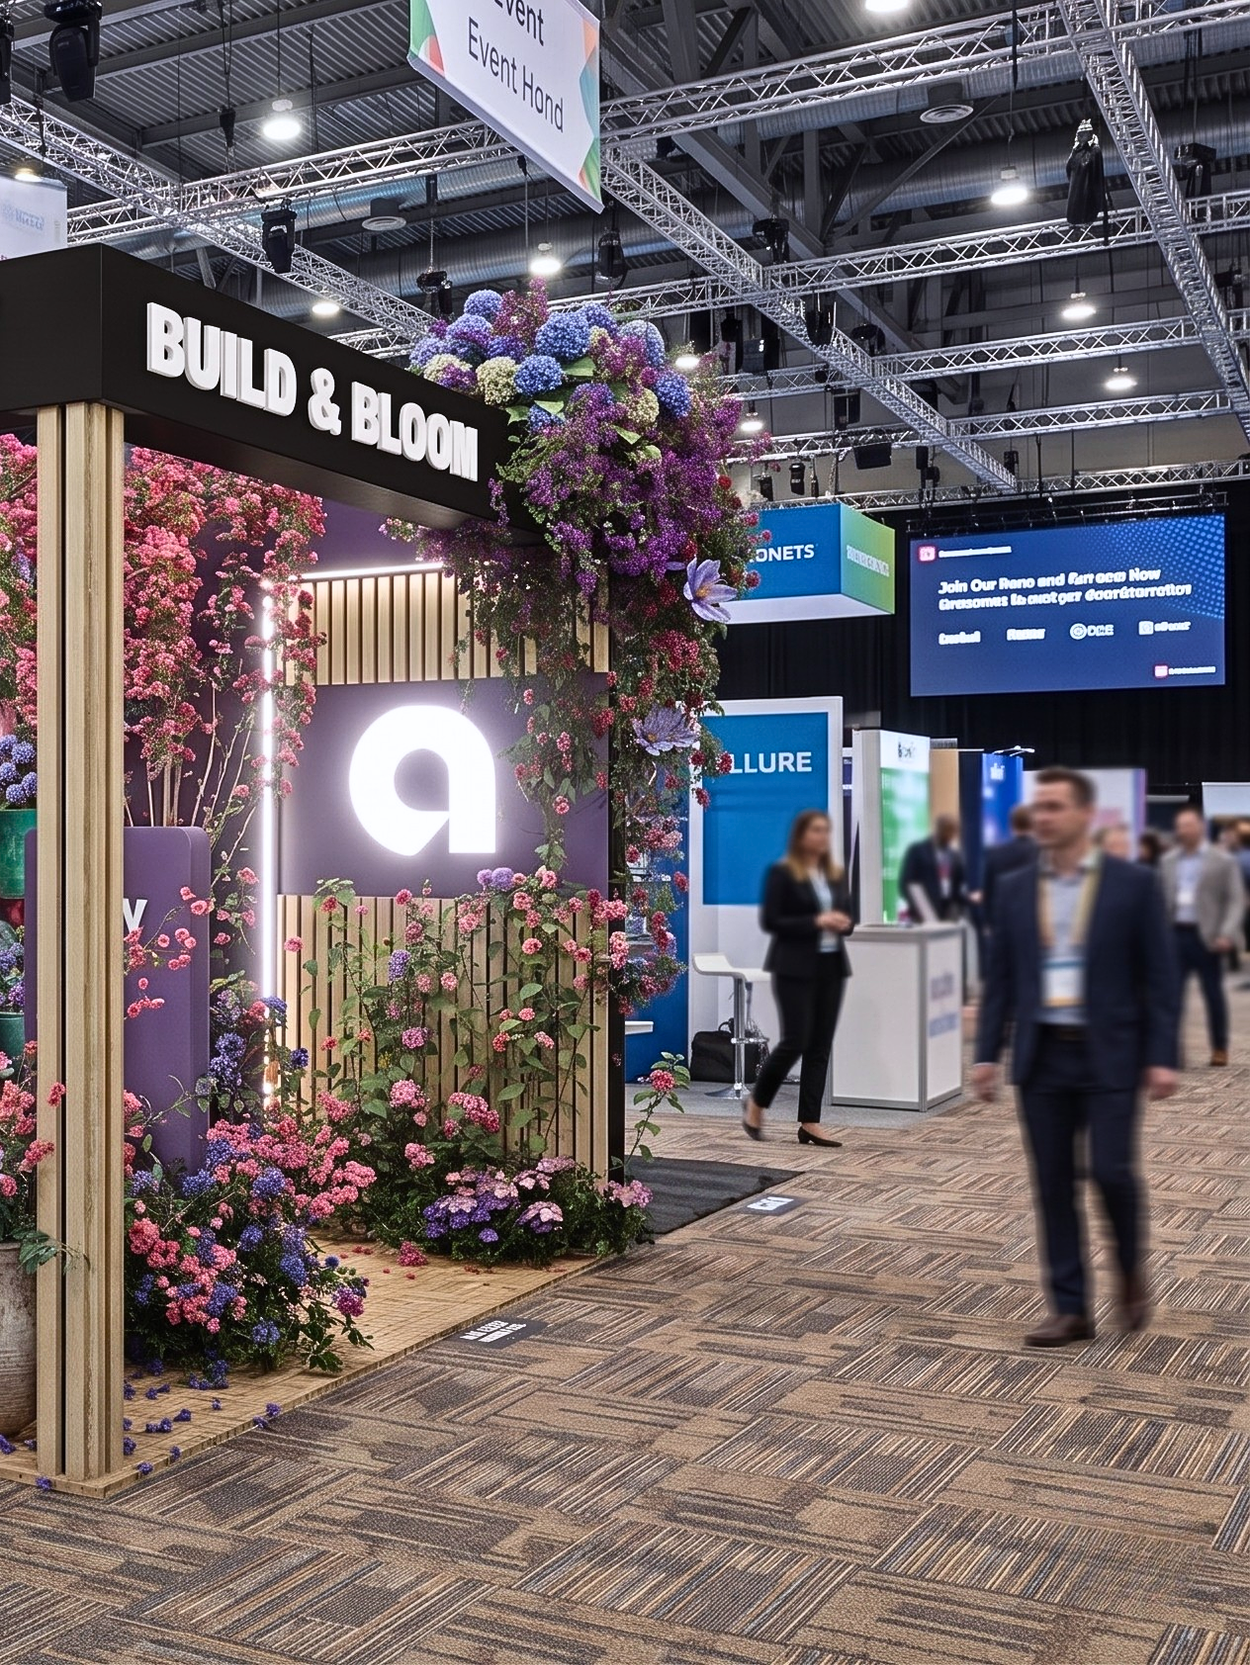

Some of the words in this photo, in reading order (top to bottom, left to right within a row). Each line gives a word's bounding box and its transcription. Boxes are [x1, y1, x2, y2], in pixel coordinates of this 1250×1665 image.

[468, 16, 517, 95] Event
[494, 0, 544, 47] vent
[147, 302, 297, 416] BUILD
[308, 368, 341, 435] &
[351, 381, 478, 482] BLOOM
[970, 579, 997, 592] Our
[349, 705, 496, 857] a
